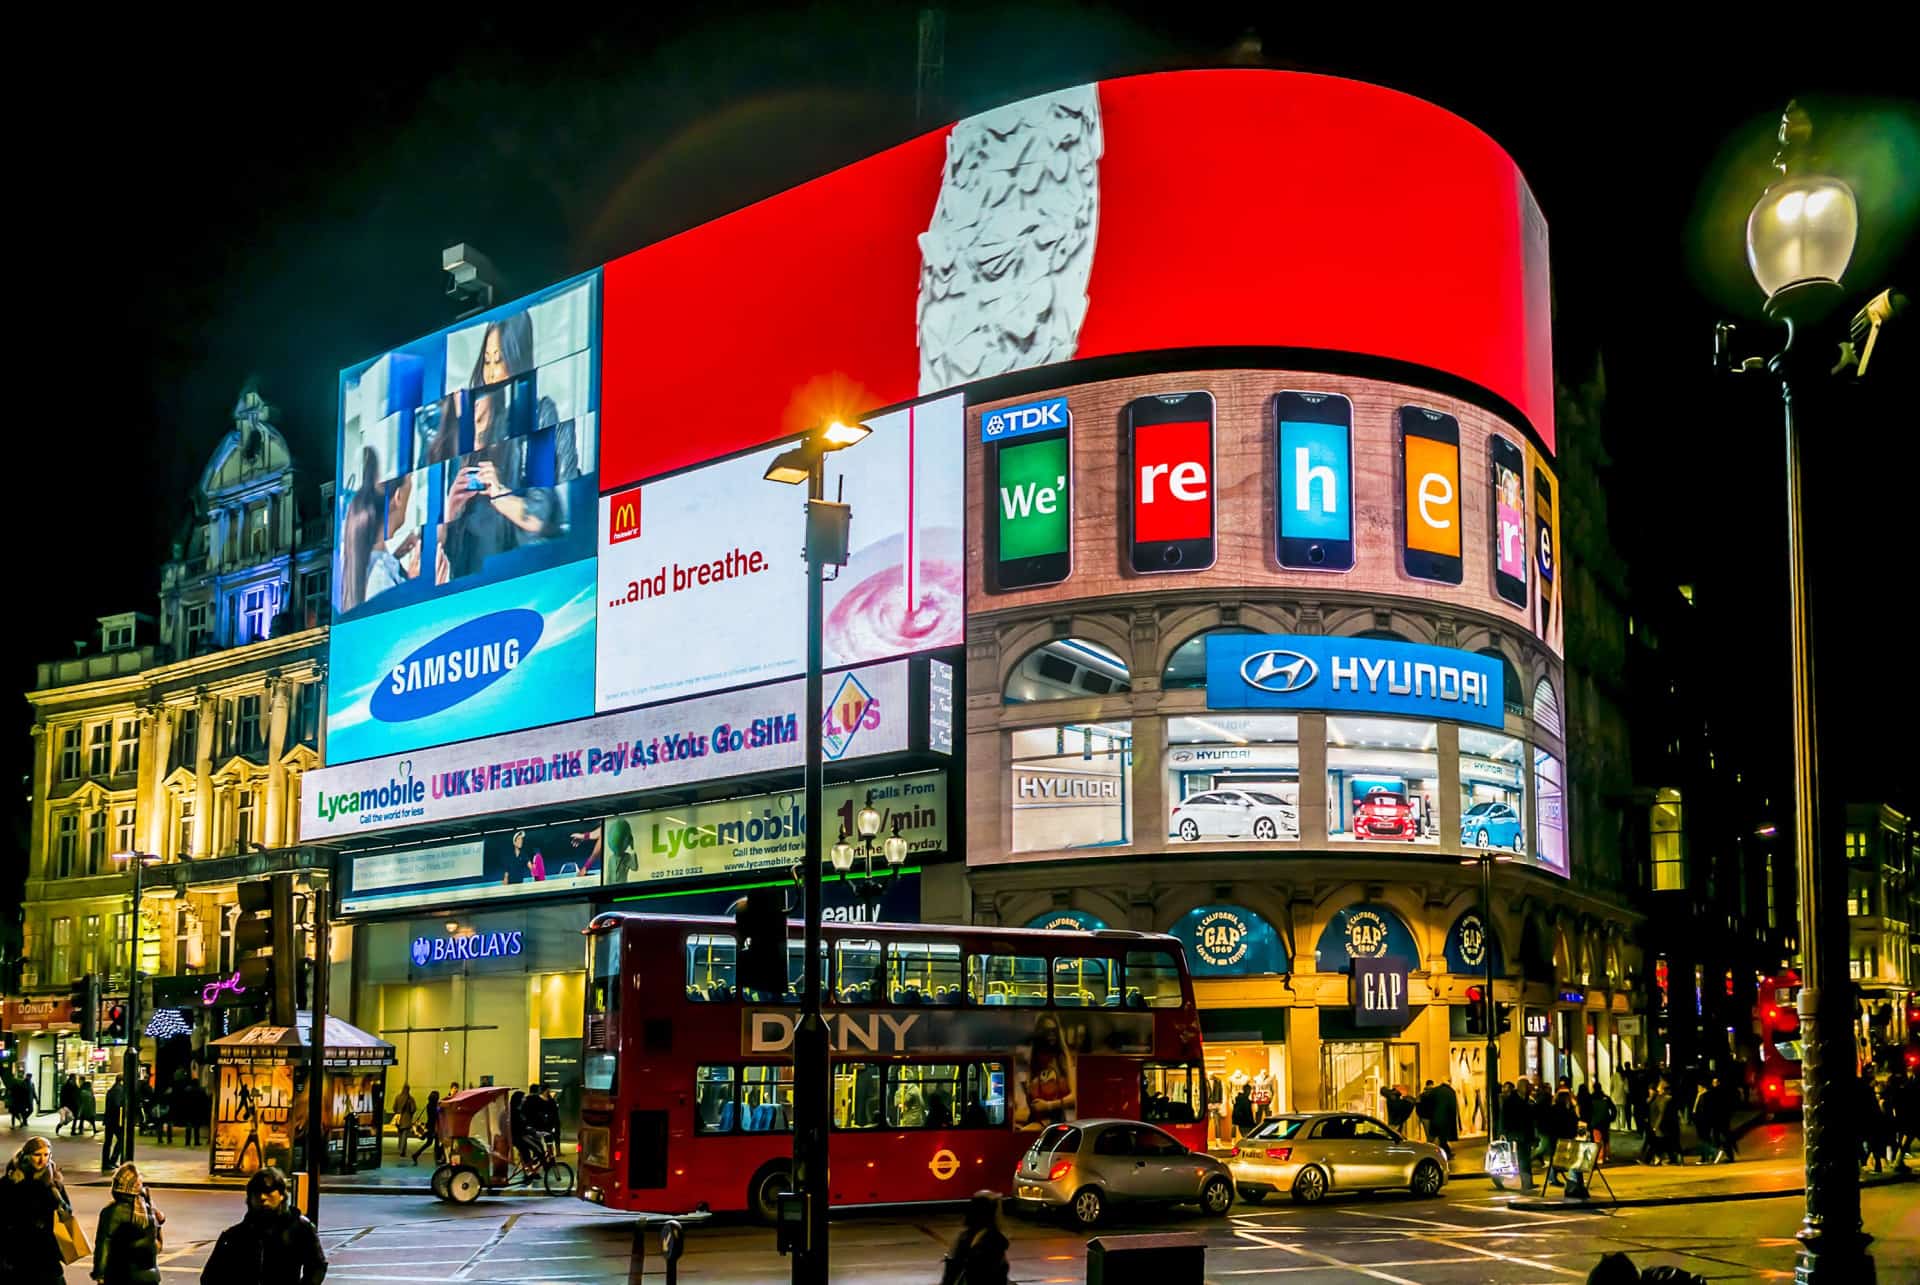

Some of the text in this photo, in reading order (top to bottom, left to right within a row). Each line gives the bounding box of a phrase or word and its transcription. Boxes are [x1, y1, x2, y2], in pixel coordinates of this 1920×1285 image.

[1003, 403, 1061, 431] TDK
[1141, 461, 1207, 503] re
[1296, 447, 1336, 513] h
[1418, 472, 1453, 529] e
[1503, 520, 1519, 563] r
[1541, 527, 1551, 569] e
[673, 548, 769, 593] breathe.
[391, 638, 520, 695] SAMSUNG
[1332, 656, 1487, 707] HYUNDAI
[489, 753, 582, 790] Favourite
[587, 748, 625, 776] Pay
[630, 740, 658, 767] As
[664, 733, 704, 760] You
[712, 725, 744, 754] Go
[751, 713, 797, 747] SIM
[1196, 749, 1250, 760] HYUNDAI
[318, 776, 425, 822] Lycamobile
[869, 782, 935, 800] Calls From
[1019, 776, 1118, 799] HYUNDAI
[360, 807, 424, 824] Call the world for less
[837, 800, 937, 842] 1/min
[733, 841, 800, 857] Call the world for
[724, 856, 801, 871] www.lycamobile.c
[434, 931, 522, 960] BARCLAYS
[1205, 926, 1240, 947] GAP
[1352, 925, 1382, 946] GAP
[1463, 928, 1482, 948] GAP
[1211, 945, 1233, 953] 1969
[1364, 973, 1401, 1011] GAP
[18, 1003, 54, 1014] DONUTS
[752, 1013, 920, 1051] DNY
[1527, 1016, 1547, 1033] GAP
